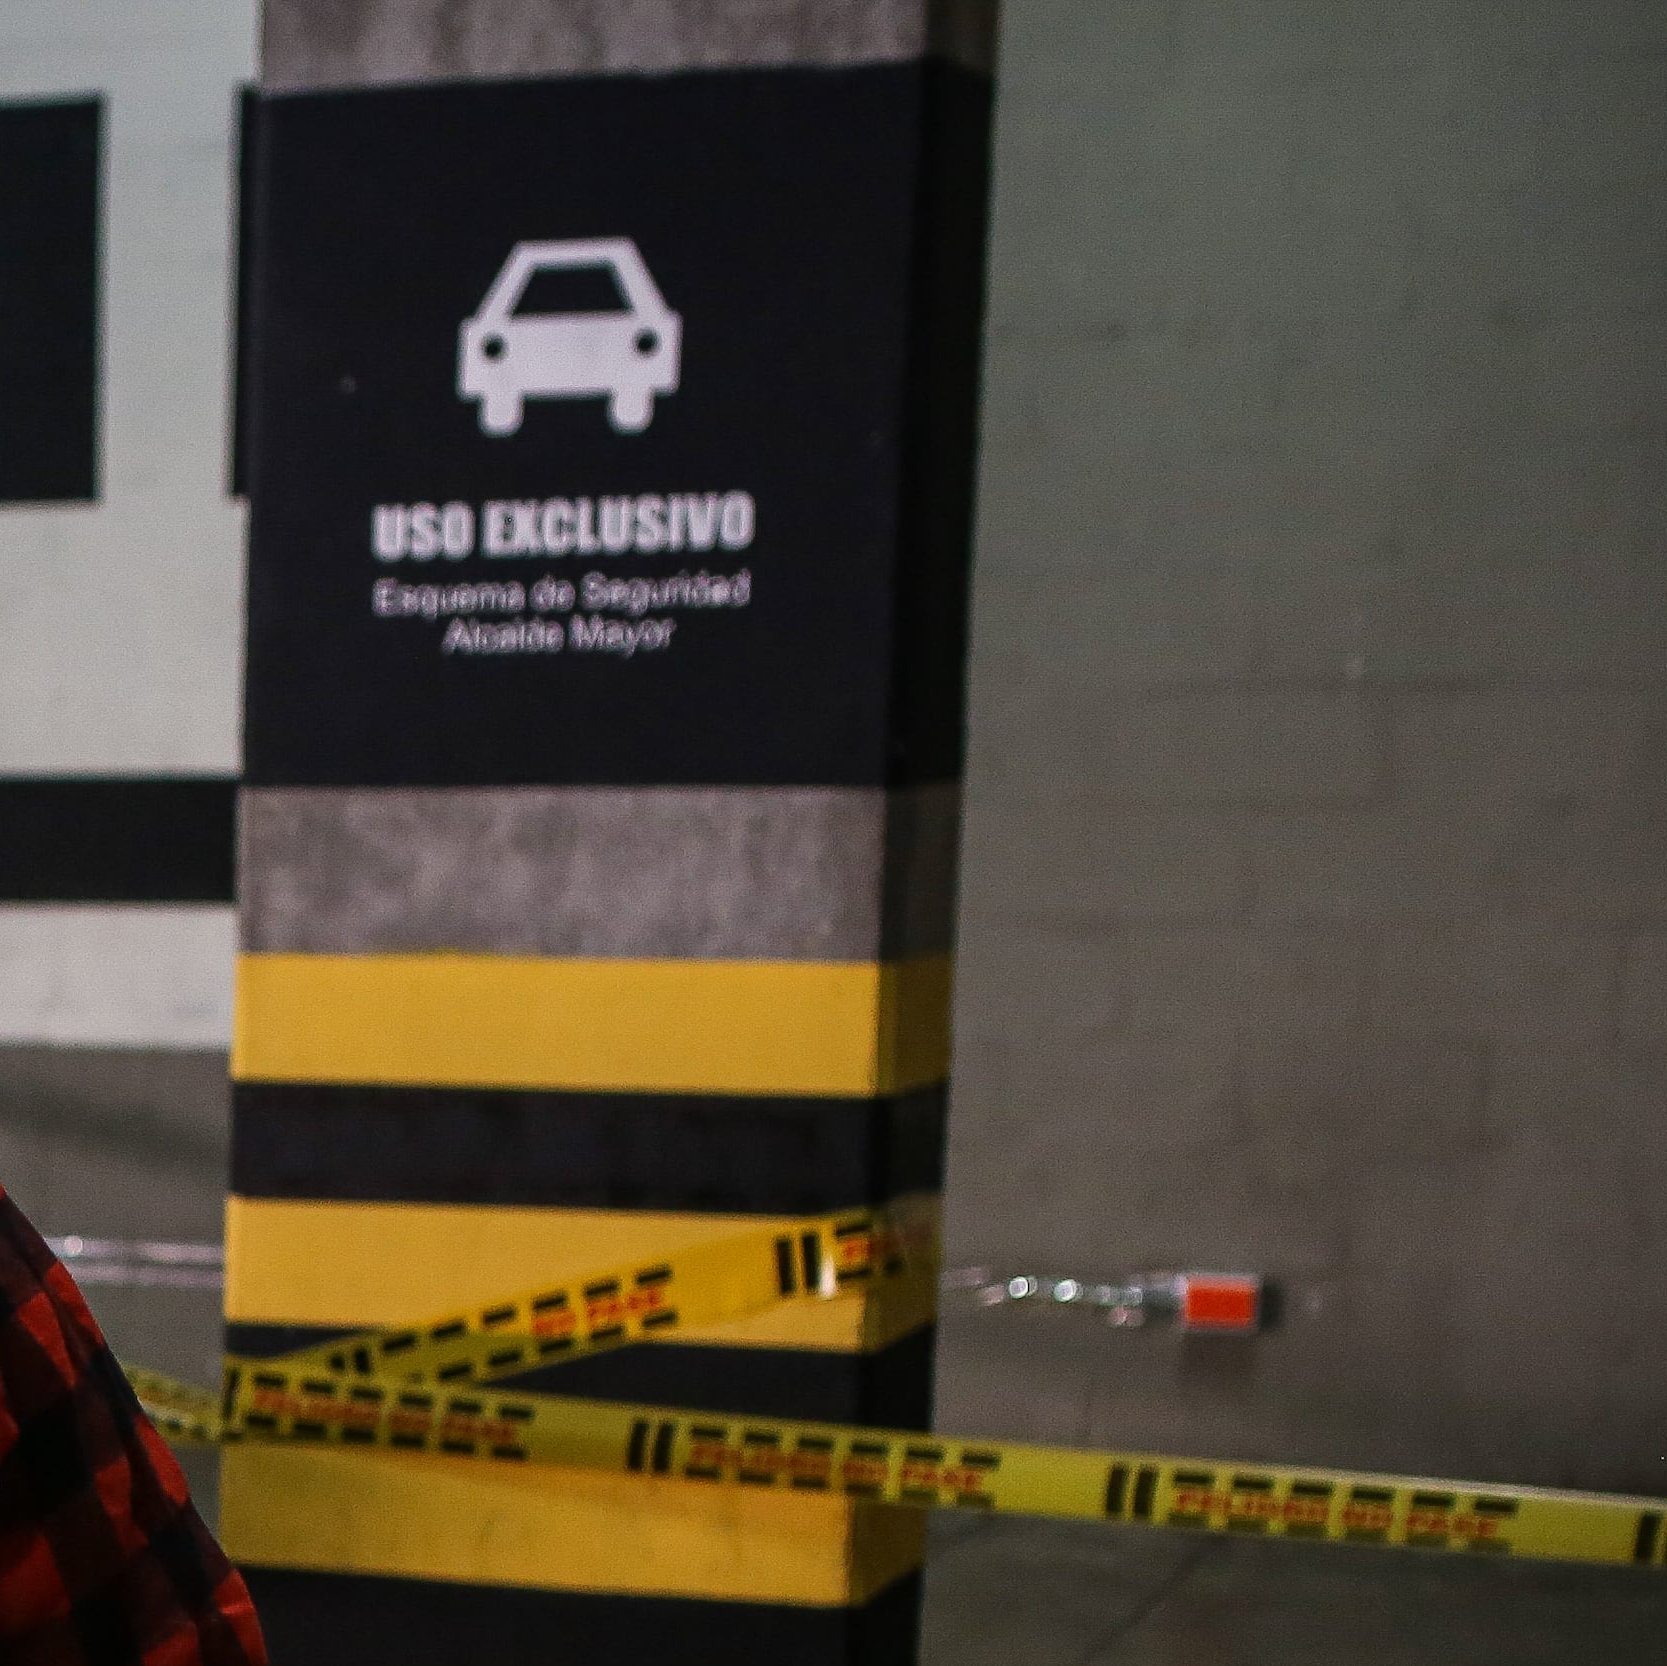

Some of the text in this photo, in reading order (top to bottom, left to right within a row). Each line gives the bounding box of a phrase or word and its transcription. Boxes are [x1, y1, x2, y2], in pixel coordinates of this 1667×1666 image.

[371, 488, 756, 562] USO EXCLUSIVO
[371, 567, 752, 619] Esquema de Seguridad
[442, 613, 676, 659] Alcalde Mayor
